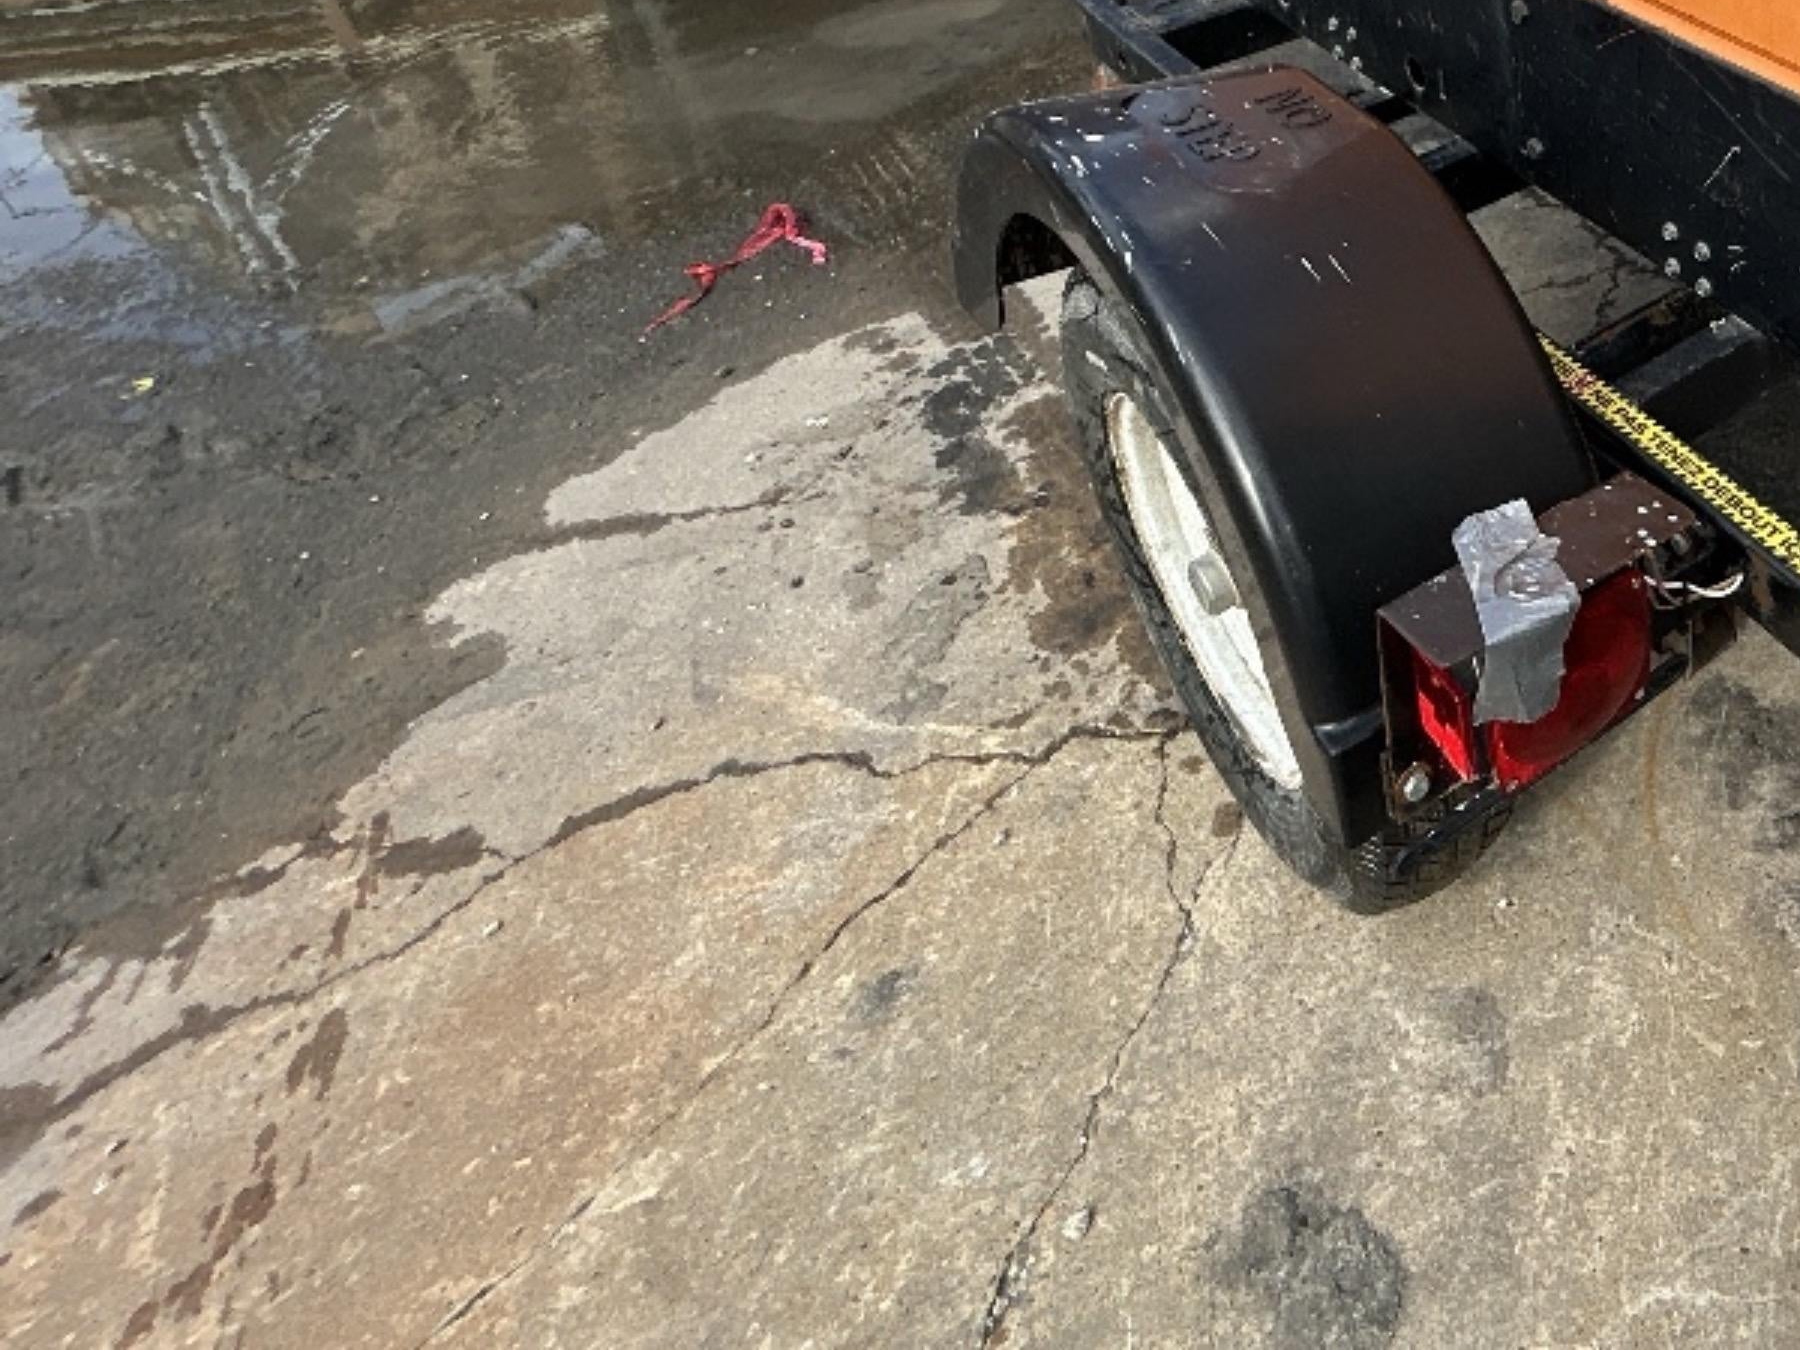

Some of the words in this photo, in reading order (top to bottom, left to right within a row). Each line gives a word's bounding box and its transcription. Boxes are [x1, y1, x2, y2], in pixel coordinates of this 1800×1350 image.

[1159, 104, 1261, 162] STEP
[1253, 86, 1333, 129] NO
[1702, 475, 1785, 538] DEBOUT
